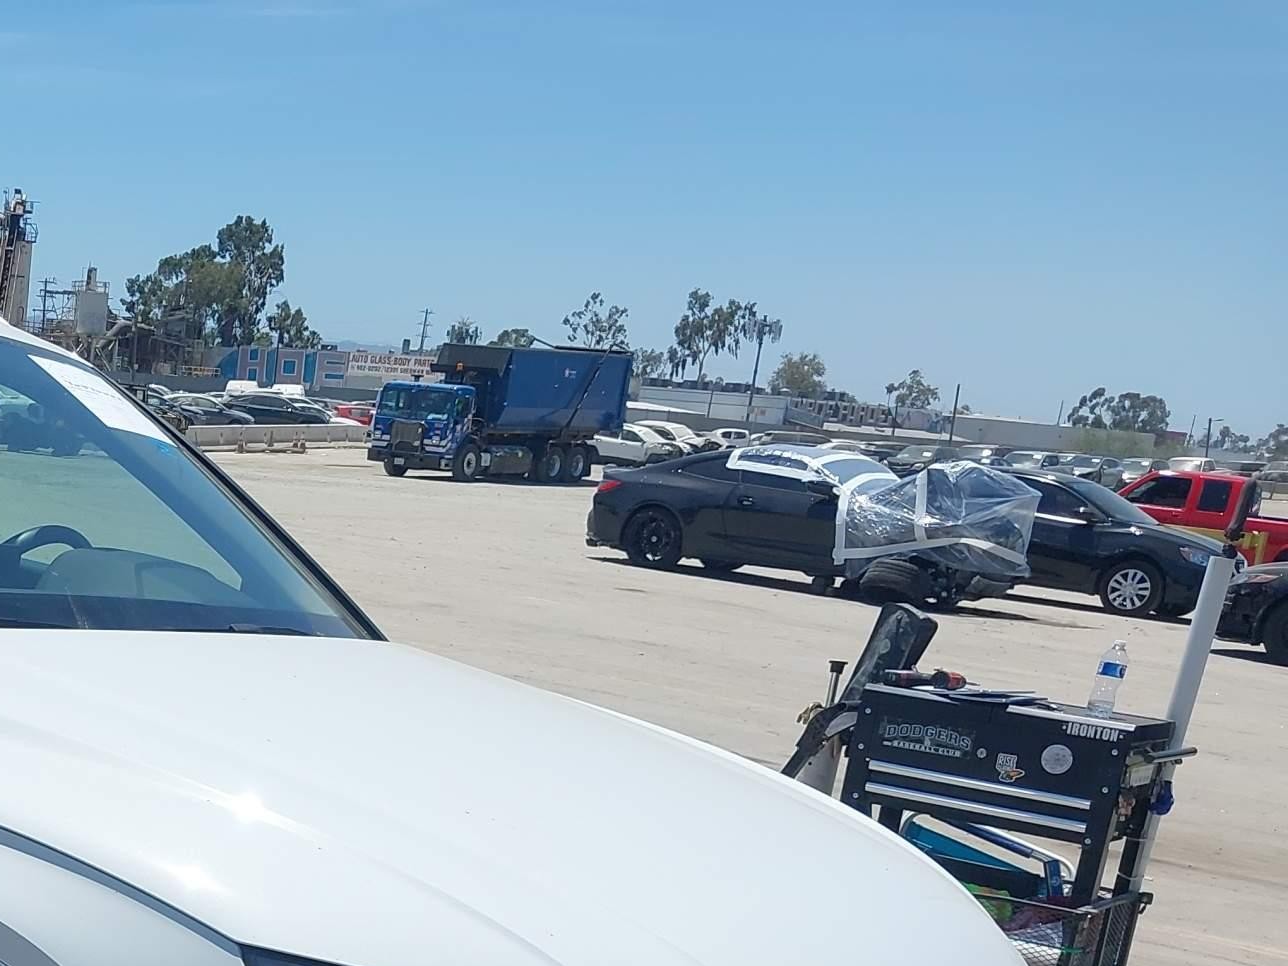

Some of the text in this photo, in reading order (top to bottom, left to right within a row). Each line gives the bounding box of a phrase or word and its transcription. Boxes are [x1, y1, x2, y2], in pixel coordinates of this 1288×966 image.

[351, 354, 368, 364] AUTO
[885, 724, 972, 750] DODGERS
[1066, 722, 1119, 742] IRONTON
[892, 739, 937, 753] BASEBALL
